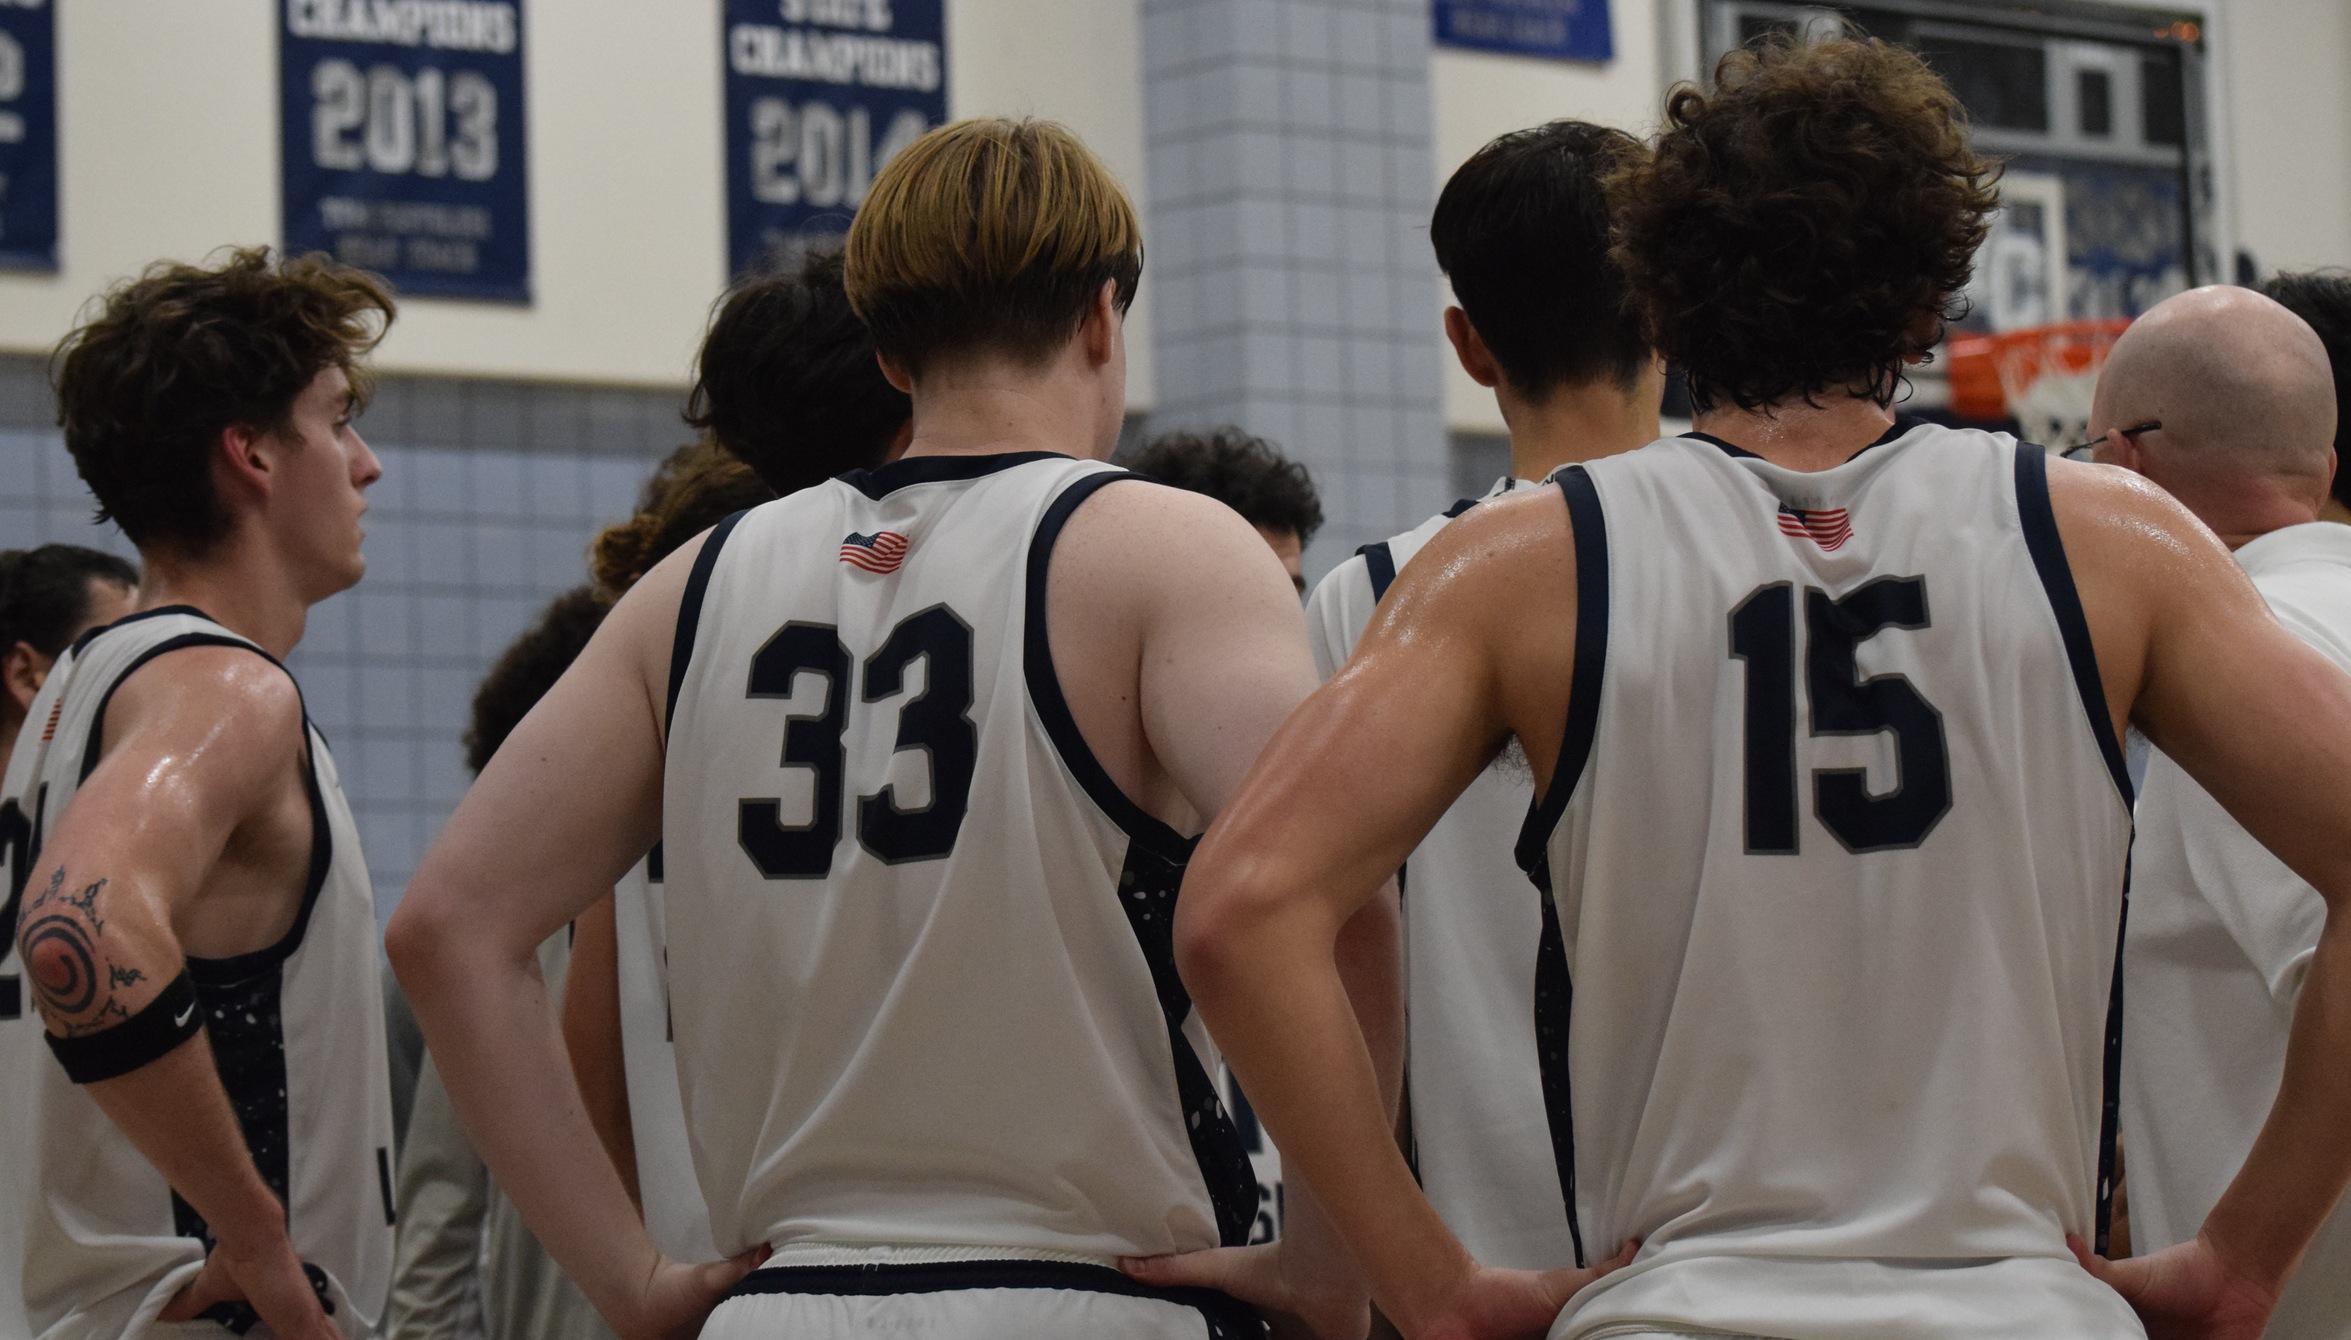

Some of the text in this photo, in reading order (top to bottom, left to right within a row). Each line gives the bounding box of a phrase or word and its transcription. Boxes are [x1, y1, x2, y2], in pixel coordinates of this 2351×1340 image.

[286, 0, 517, 53] CHAMPIONS
[730, 22, 940, 92] CHAMPIONS
[311, 58, 498, 181] 2013
[737, 602, 979, 880] 33
[1727, 574, 1954, 856] 15
